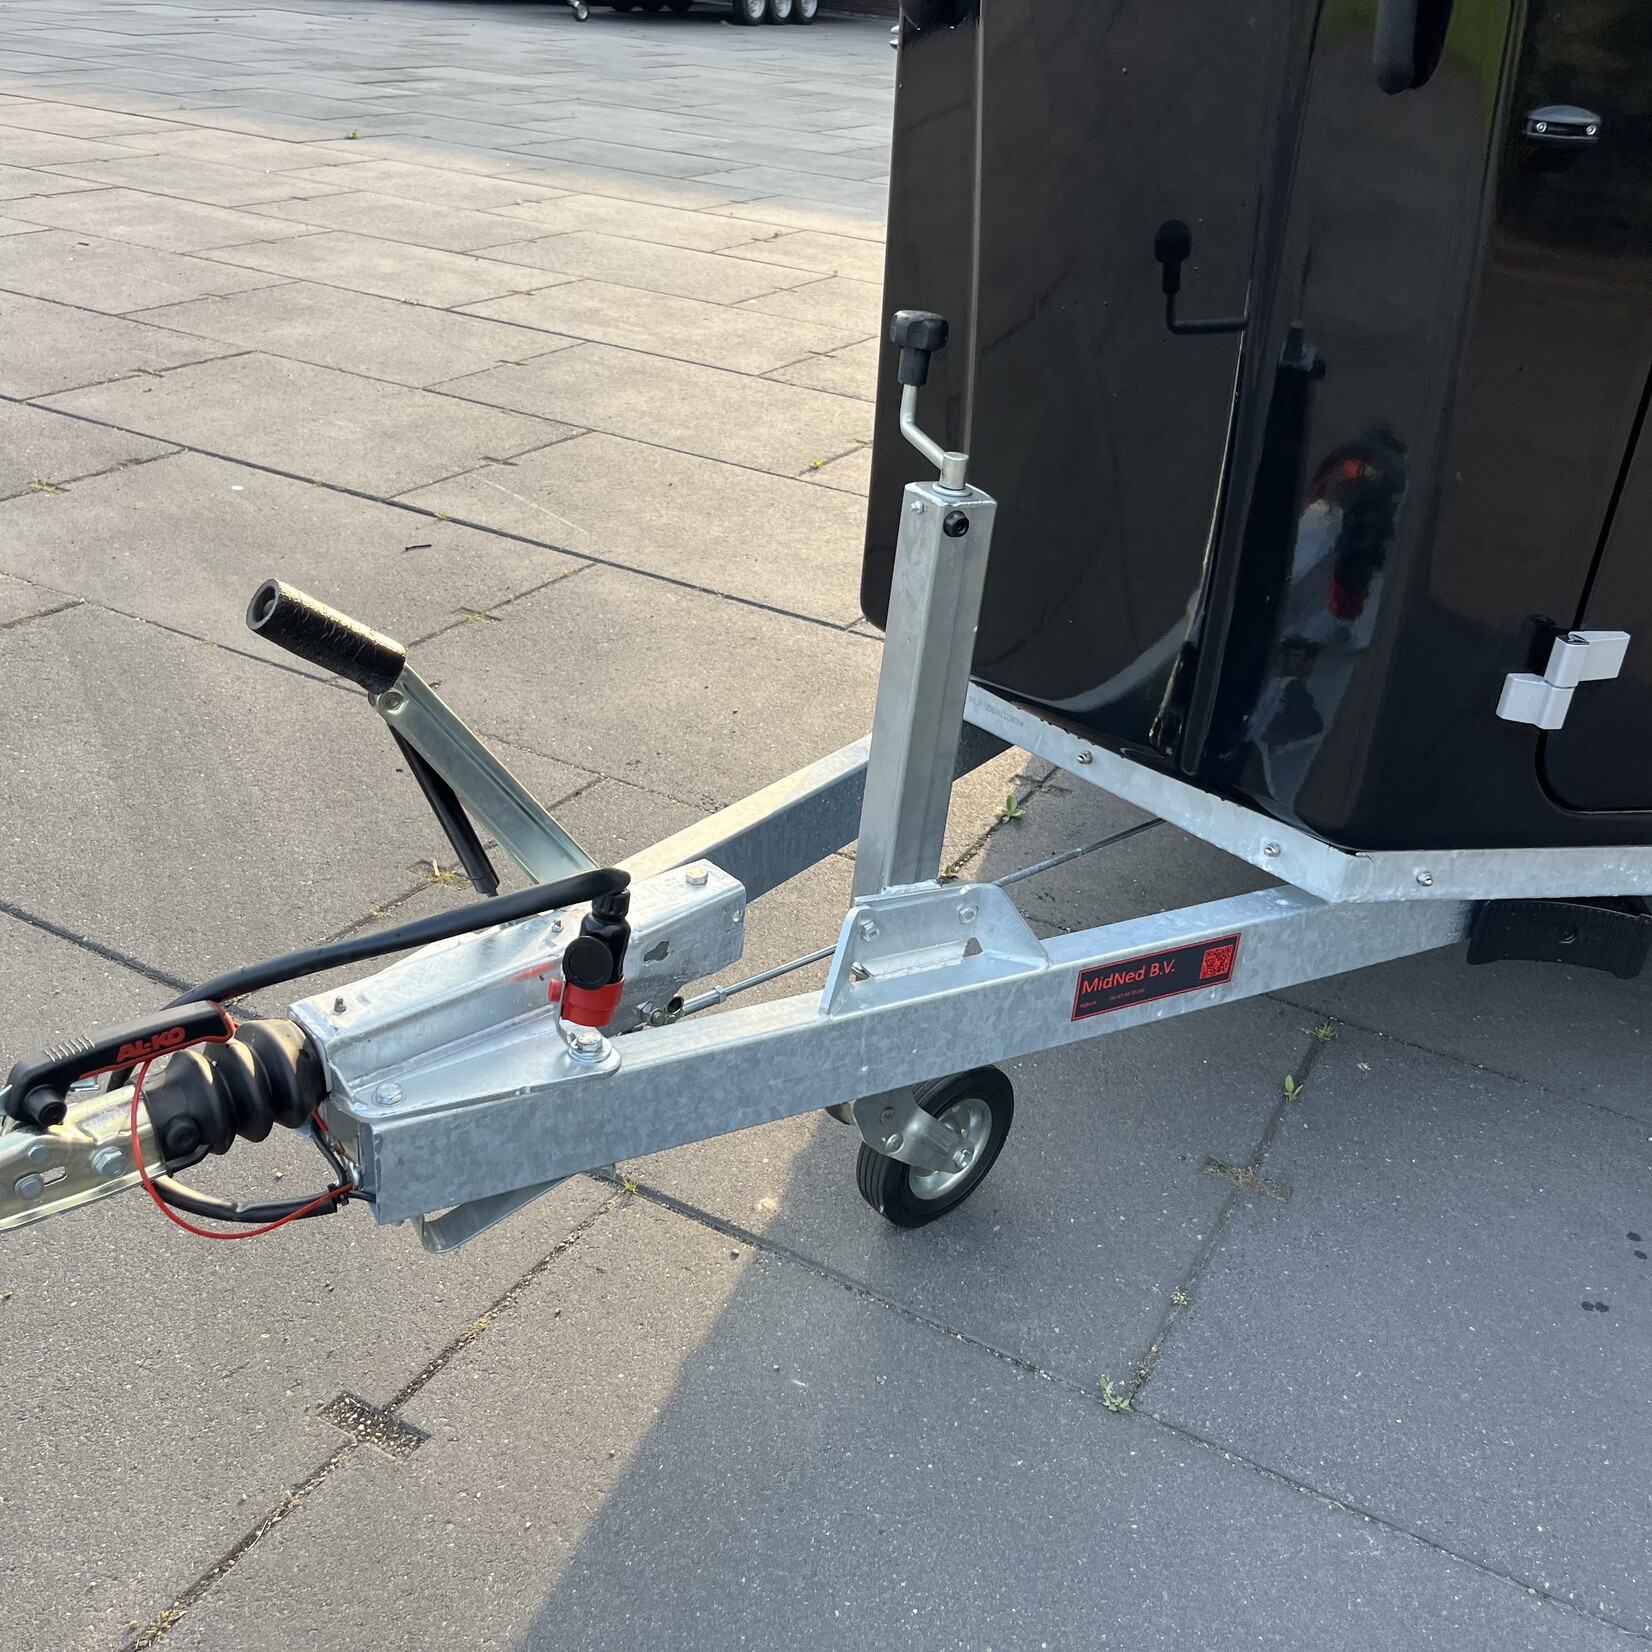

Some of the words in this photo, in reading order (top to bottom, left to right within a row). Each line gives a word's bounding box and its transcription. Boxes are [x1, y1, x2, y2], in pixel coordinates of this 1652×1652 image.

[1081, 965, 1146, 995] MidNed
[1149, 958, 1176, 978] B.V.
[116, 1026, 186, 1062] AL-KO
